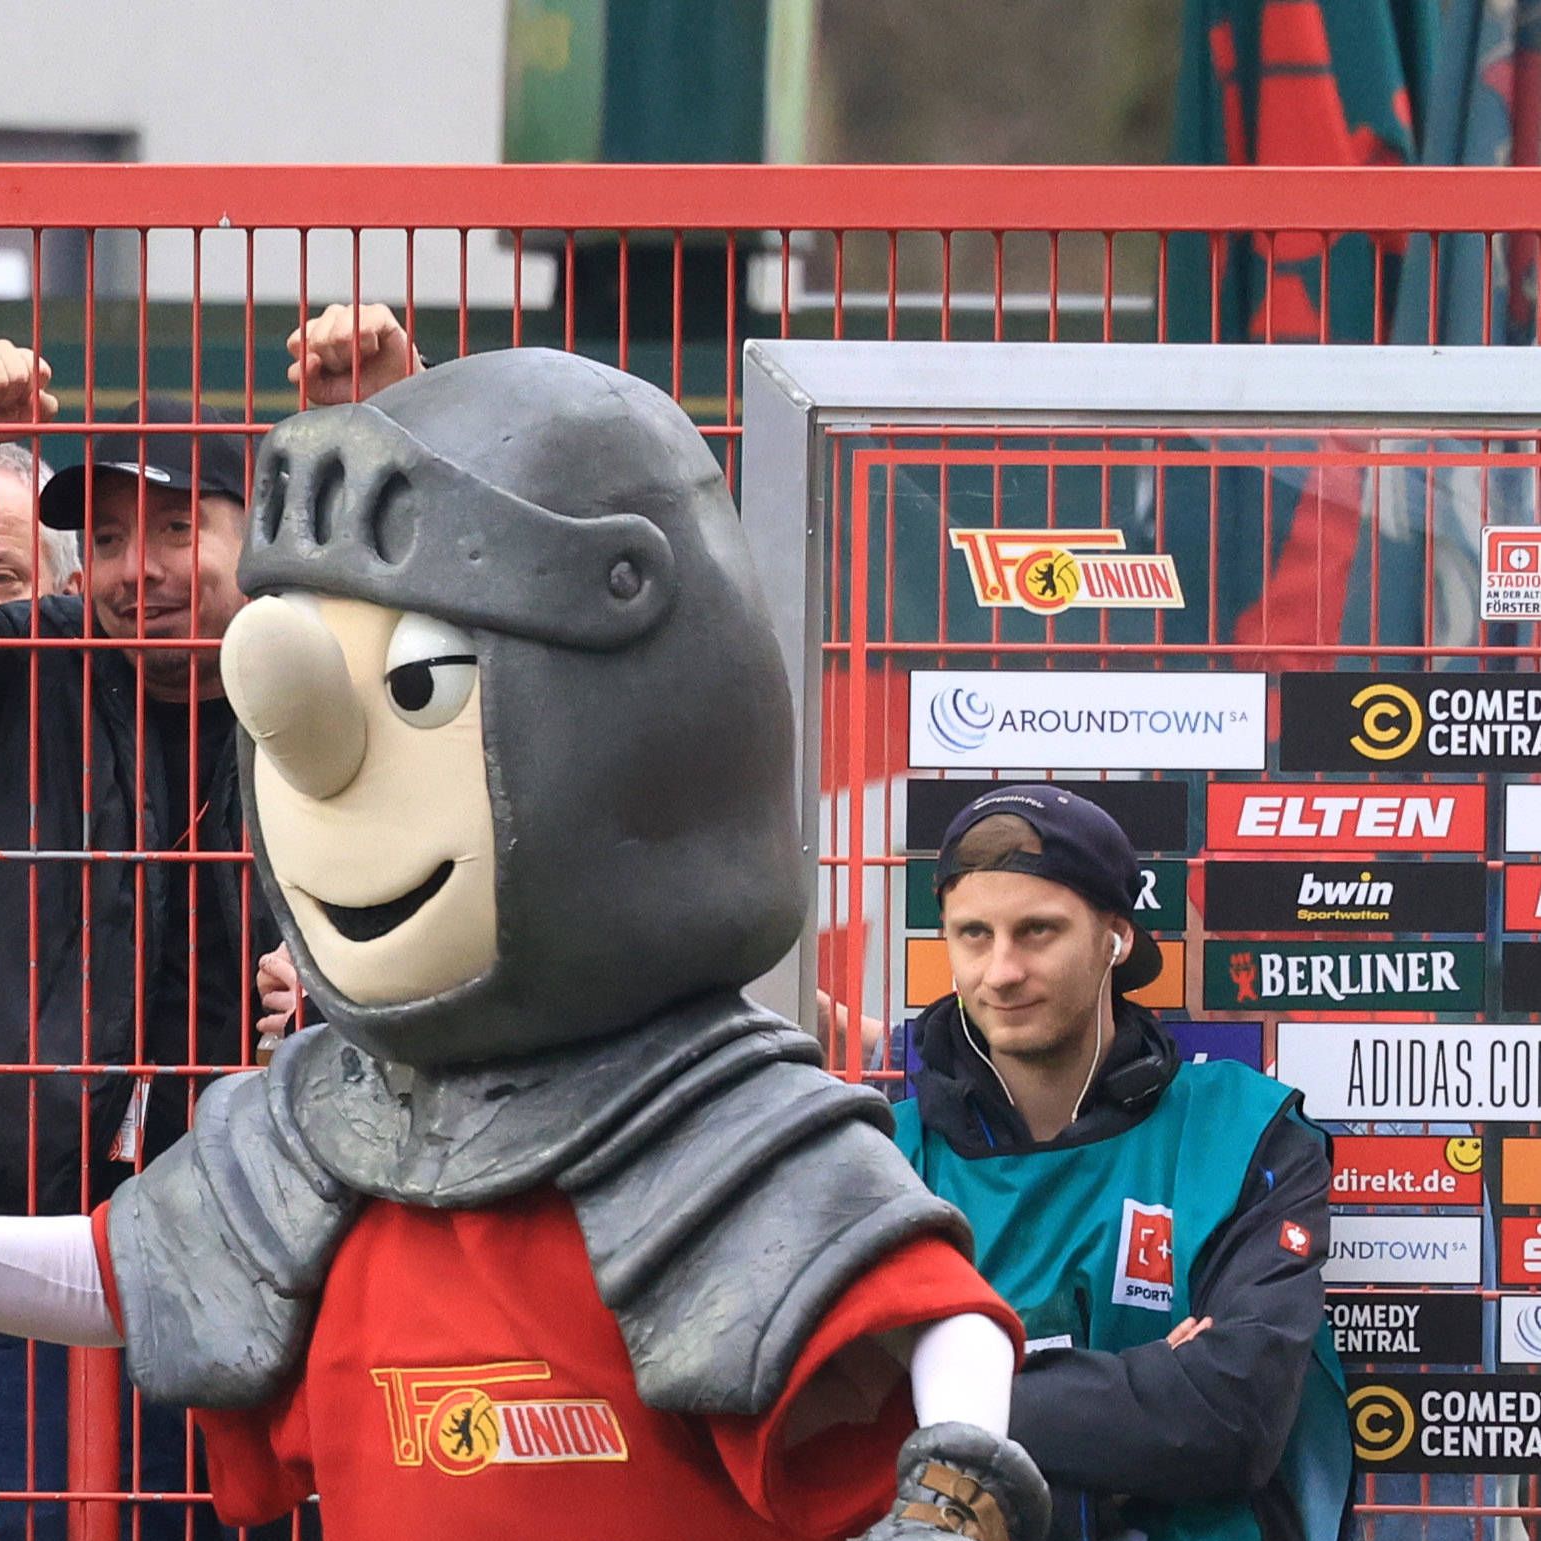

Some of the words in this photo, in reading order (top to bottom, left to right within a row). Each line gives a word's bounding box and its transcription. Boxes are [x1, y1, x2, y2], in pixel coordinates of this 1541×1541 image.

[1080, 561, 1174, 599] UNION
[1486, 590, 1500, 599] AN
[1502, 590, 1521, 599] DER
[998, 709, 1225, 734] AROUNDTOWN
[1229, 711, 1249, 722] SA
[1428, 689, 1541, 721] COMED
[1237, 796, 1455, 838] ELTEN
[1297, 871, 1394, 906] bwin
[1296, 909, 1390, 922] Sportwetten
[1260, 950, 1460, 1001] BERLINER
[1347, 1039, 1541, 1108] ADIDAS.CO
[1333, 1168, 1456, 1194] direkt.de
[1452, 1242, 1468, 1252] SA
[1333, 1330, 1421, 1353] ENTRAL
[1421, 1390, 1541, 1423] COMED
[502, 1405, 622, 1457] UNION
[1421, 1425, 1541, 1458] CENTRA
